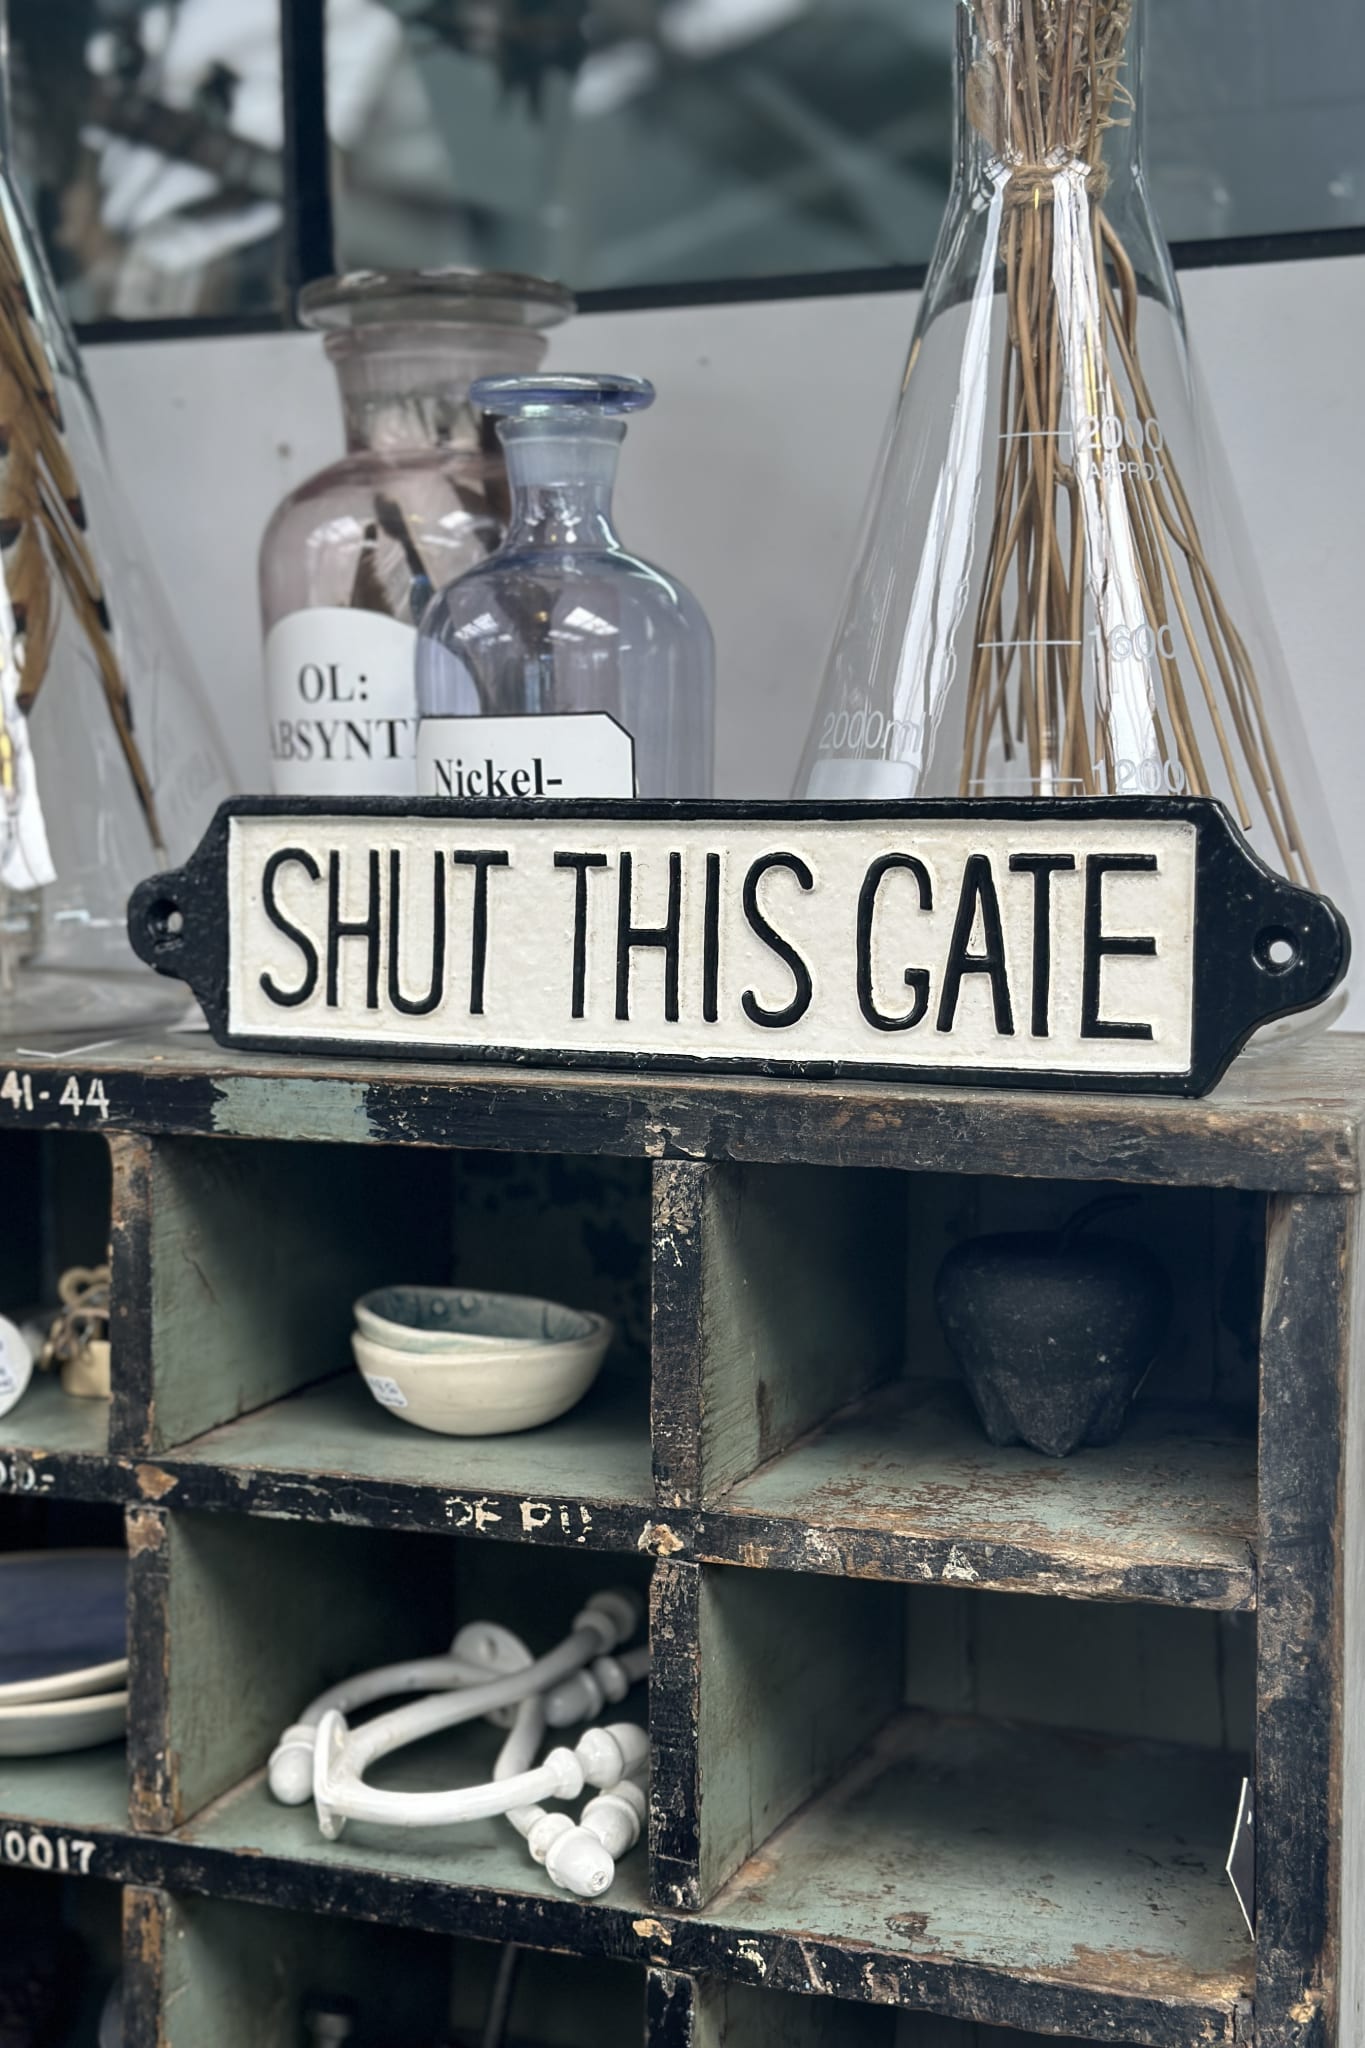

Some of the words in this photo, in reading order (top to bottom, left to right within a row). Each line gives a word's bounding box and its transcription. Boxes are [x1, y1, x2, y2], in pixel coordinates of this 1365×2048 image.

[1079, 415, 1162, 451] 2000
[299, 662, 368, 702] OL:
[270, 719, 417, 762] BSYNT
[433, 758, 562, 798] Nickel-
[259, 847, 509, 1015] SHUT
[553, 851, 814, 1028] THIS
[856, 852, 1159, 1041] GATE
[0, 1829, 98, 1877] 0017
